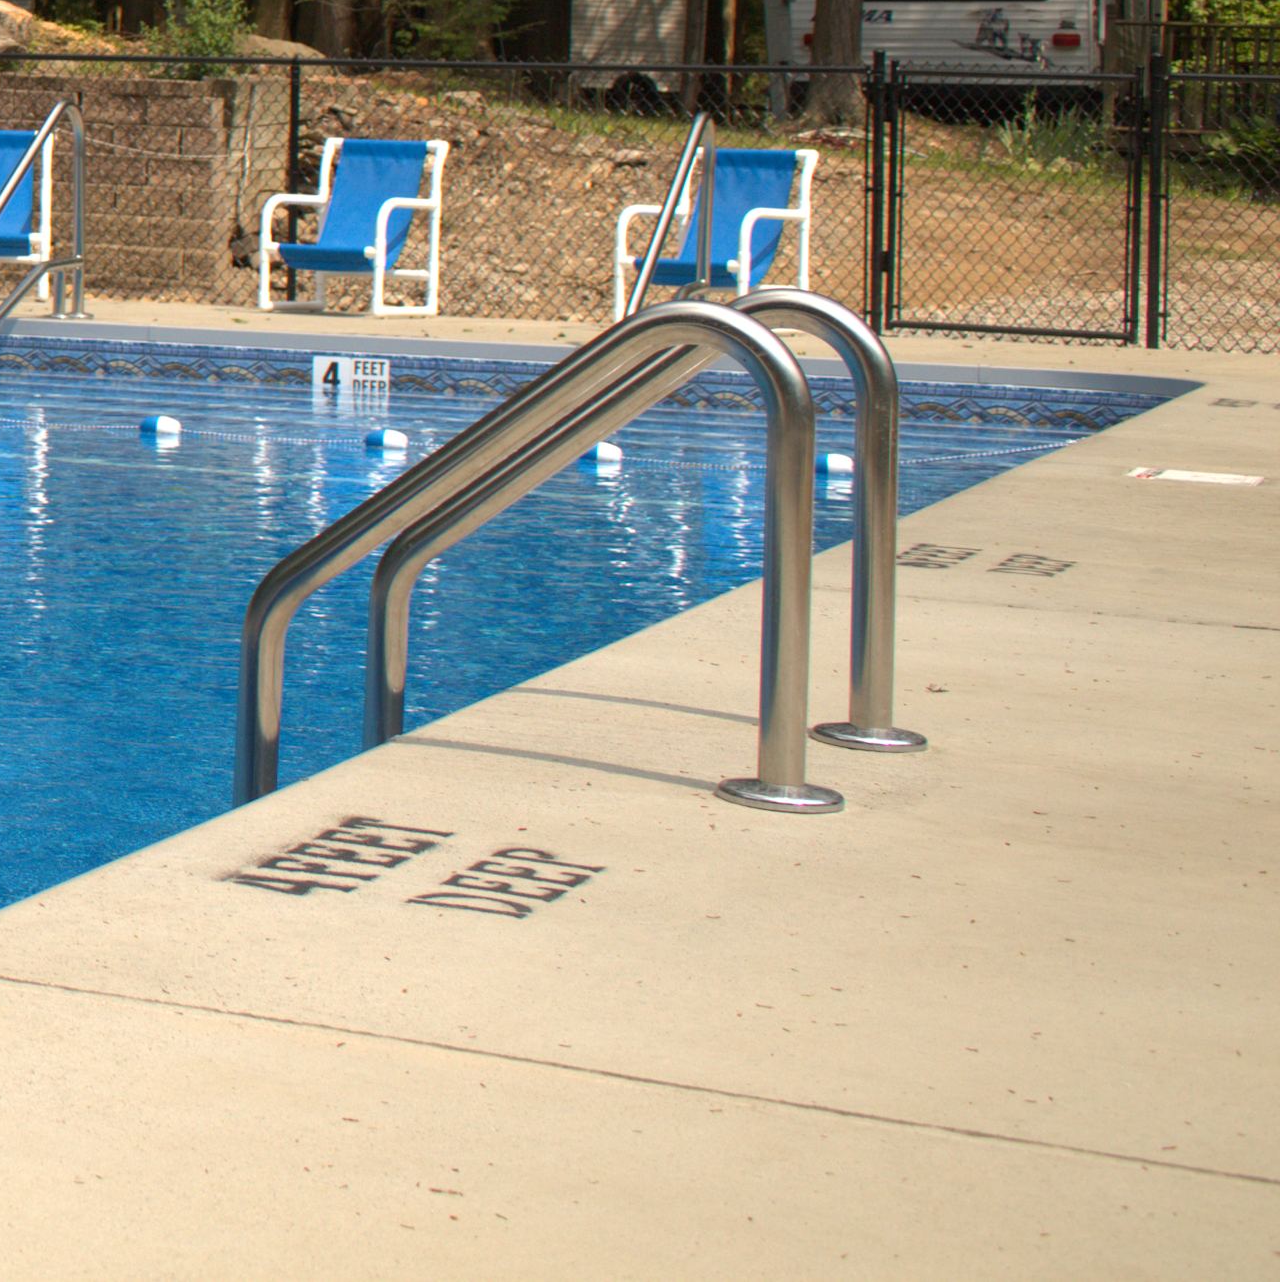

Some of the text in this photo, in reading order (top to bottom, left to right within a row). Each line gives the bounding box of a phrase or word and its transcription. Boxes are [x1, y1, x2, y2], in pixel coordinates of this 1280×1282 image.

[322, 361, 386, 386] 4 FEET
[406, 847, 607, 919] DEEP
